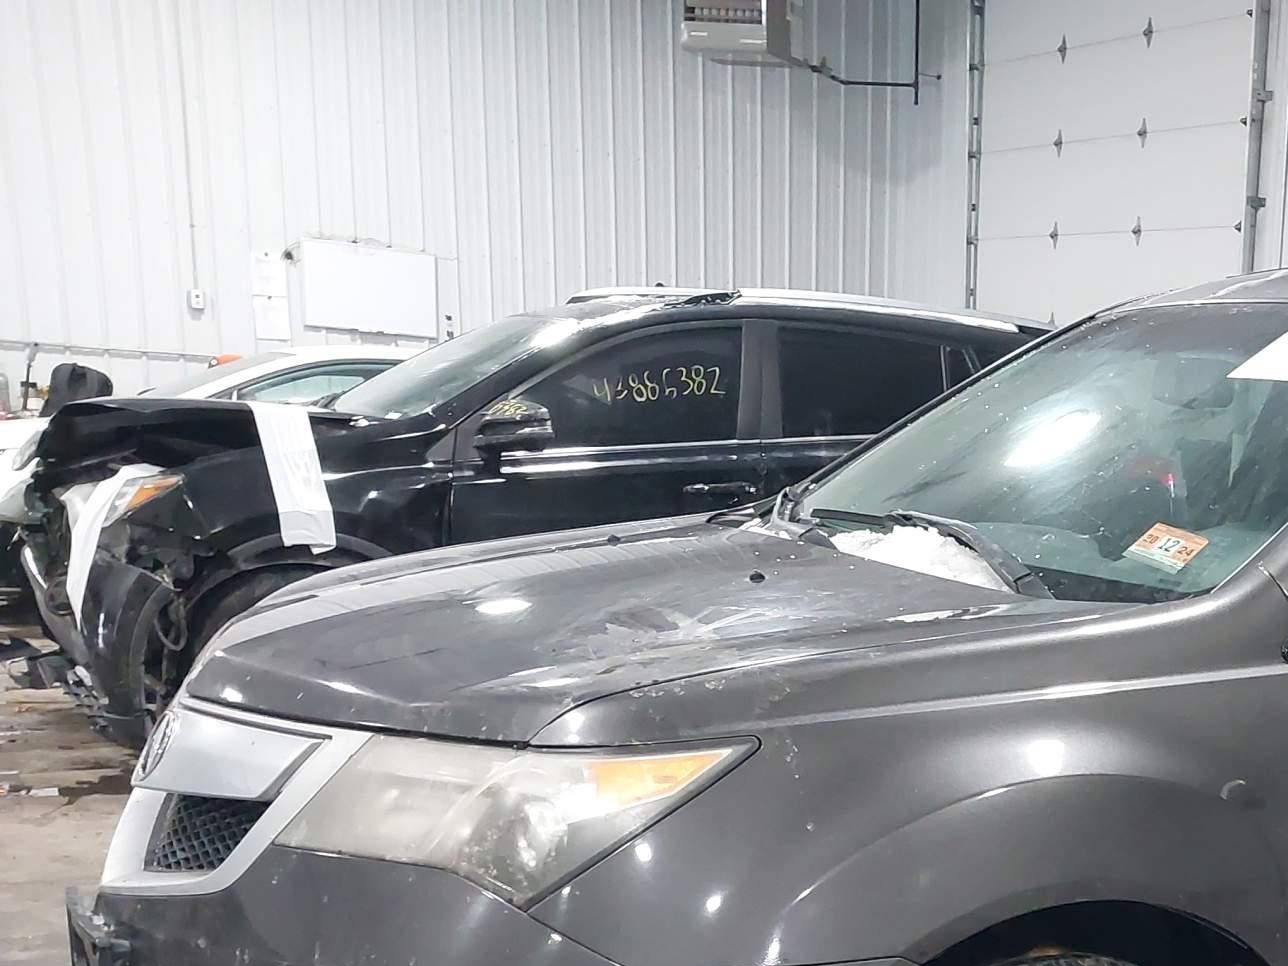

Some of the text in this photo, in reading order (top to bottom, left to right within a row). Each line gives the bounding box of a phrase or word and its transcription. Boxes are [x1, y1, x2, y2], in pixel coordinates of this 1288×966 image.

[1142, 533, 1195, 557] 20 12 24
